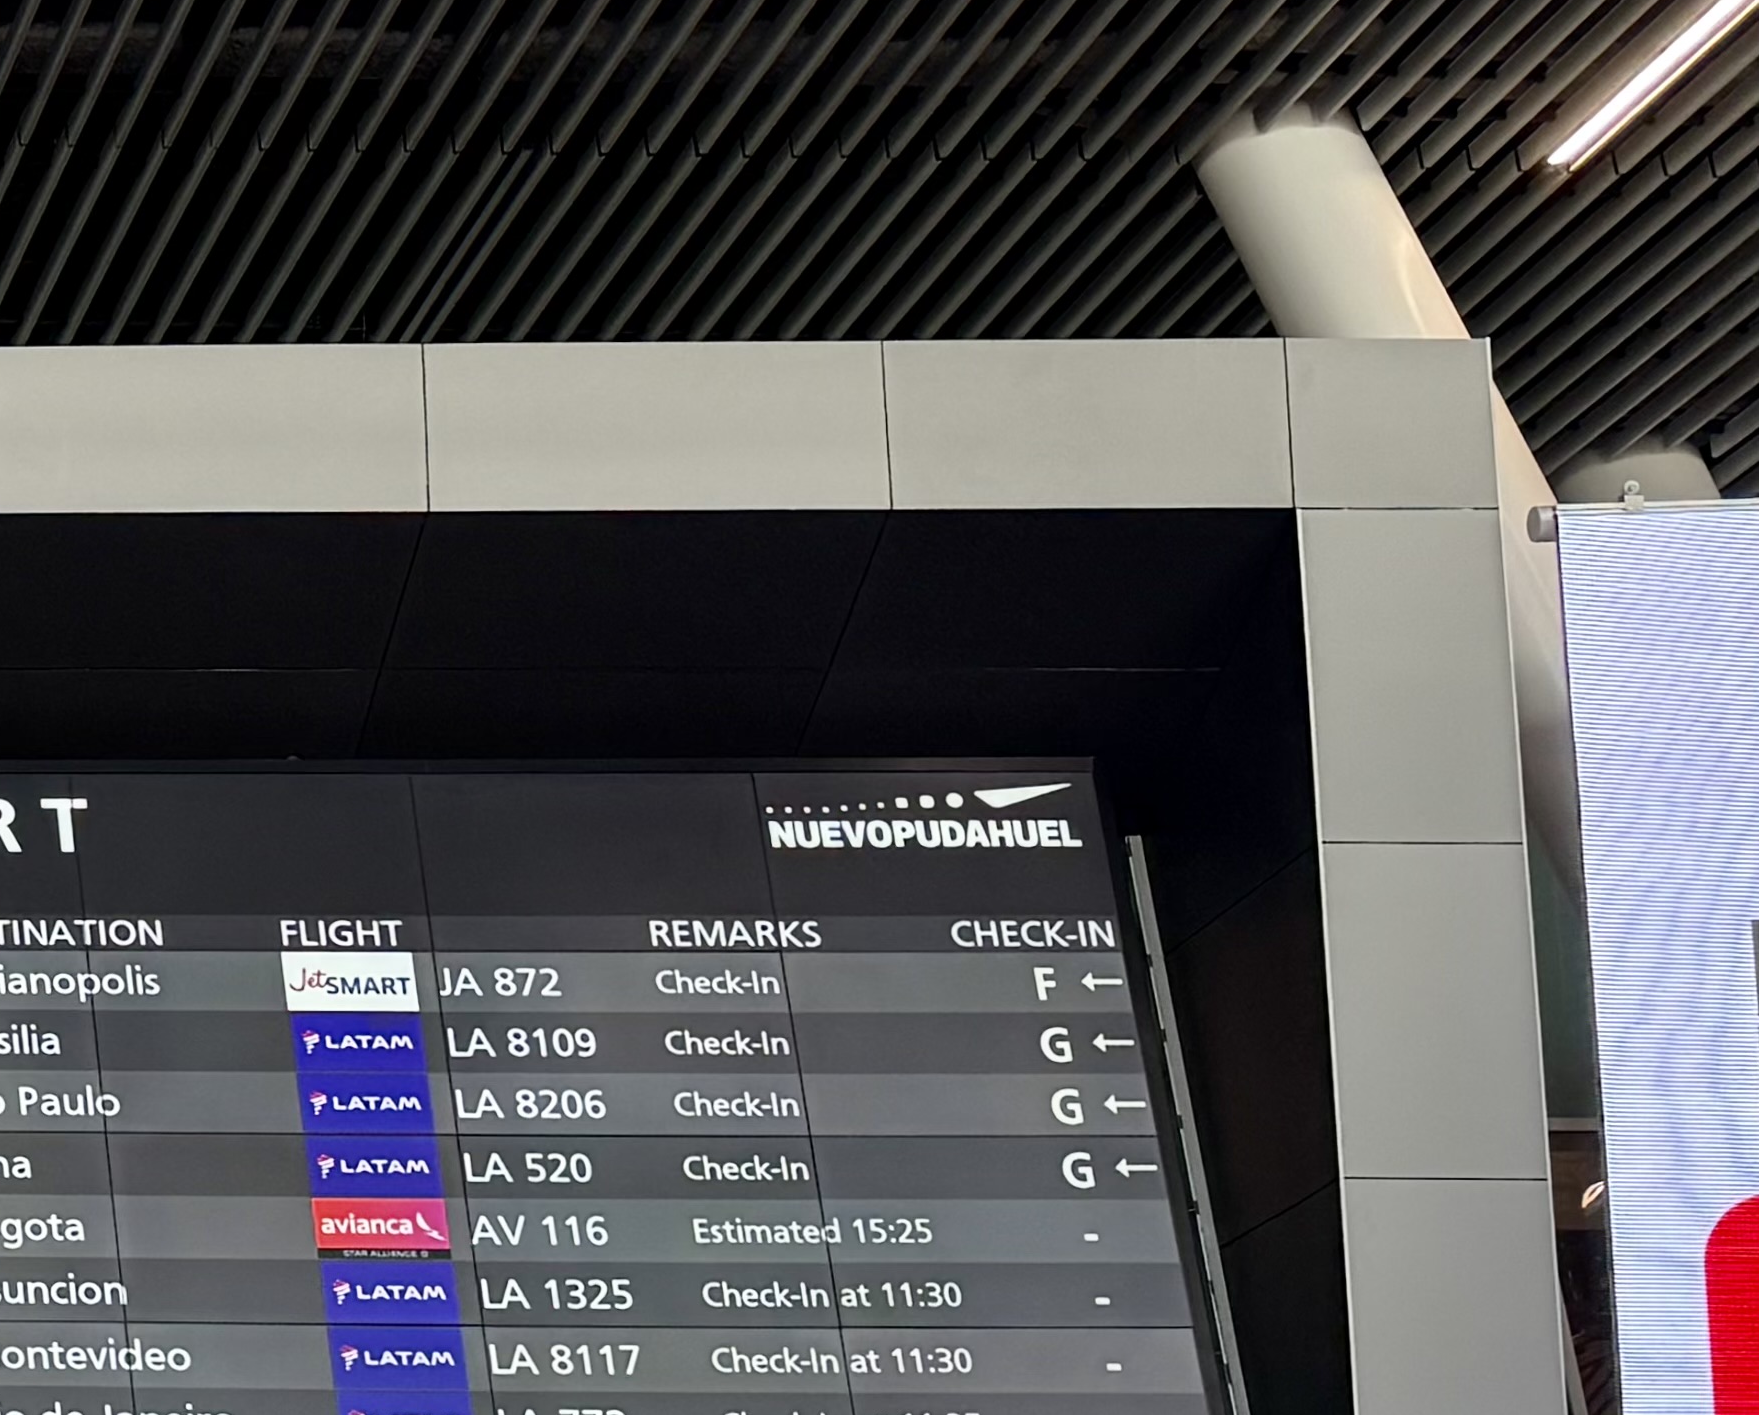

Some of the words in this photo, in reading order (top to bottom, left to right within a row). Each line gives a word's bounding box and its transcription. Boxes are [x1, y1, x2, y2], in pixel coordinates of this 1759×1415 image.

[768, 820, 1082, 848] NUEVOPUDAHUEL
[290, 969, 410, 994] JetSMART
[440, 968, 483, 996] JA
[494, 968, 561, 996] 872
[656, 970, 780, 994] Check-In
[1034, 968, 1056, 1000] F
[322, 1213, 413, 1234] avianca
[473, 1215, 524, 1245] AV
[542, 1216, 608, 1245] 116
[693, 1218, 841, 1243] Estimated
[853, 1219, 932, 1243] 15:25
